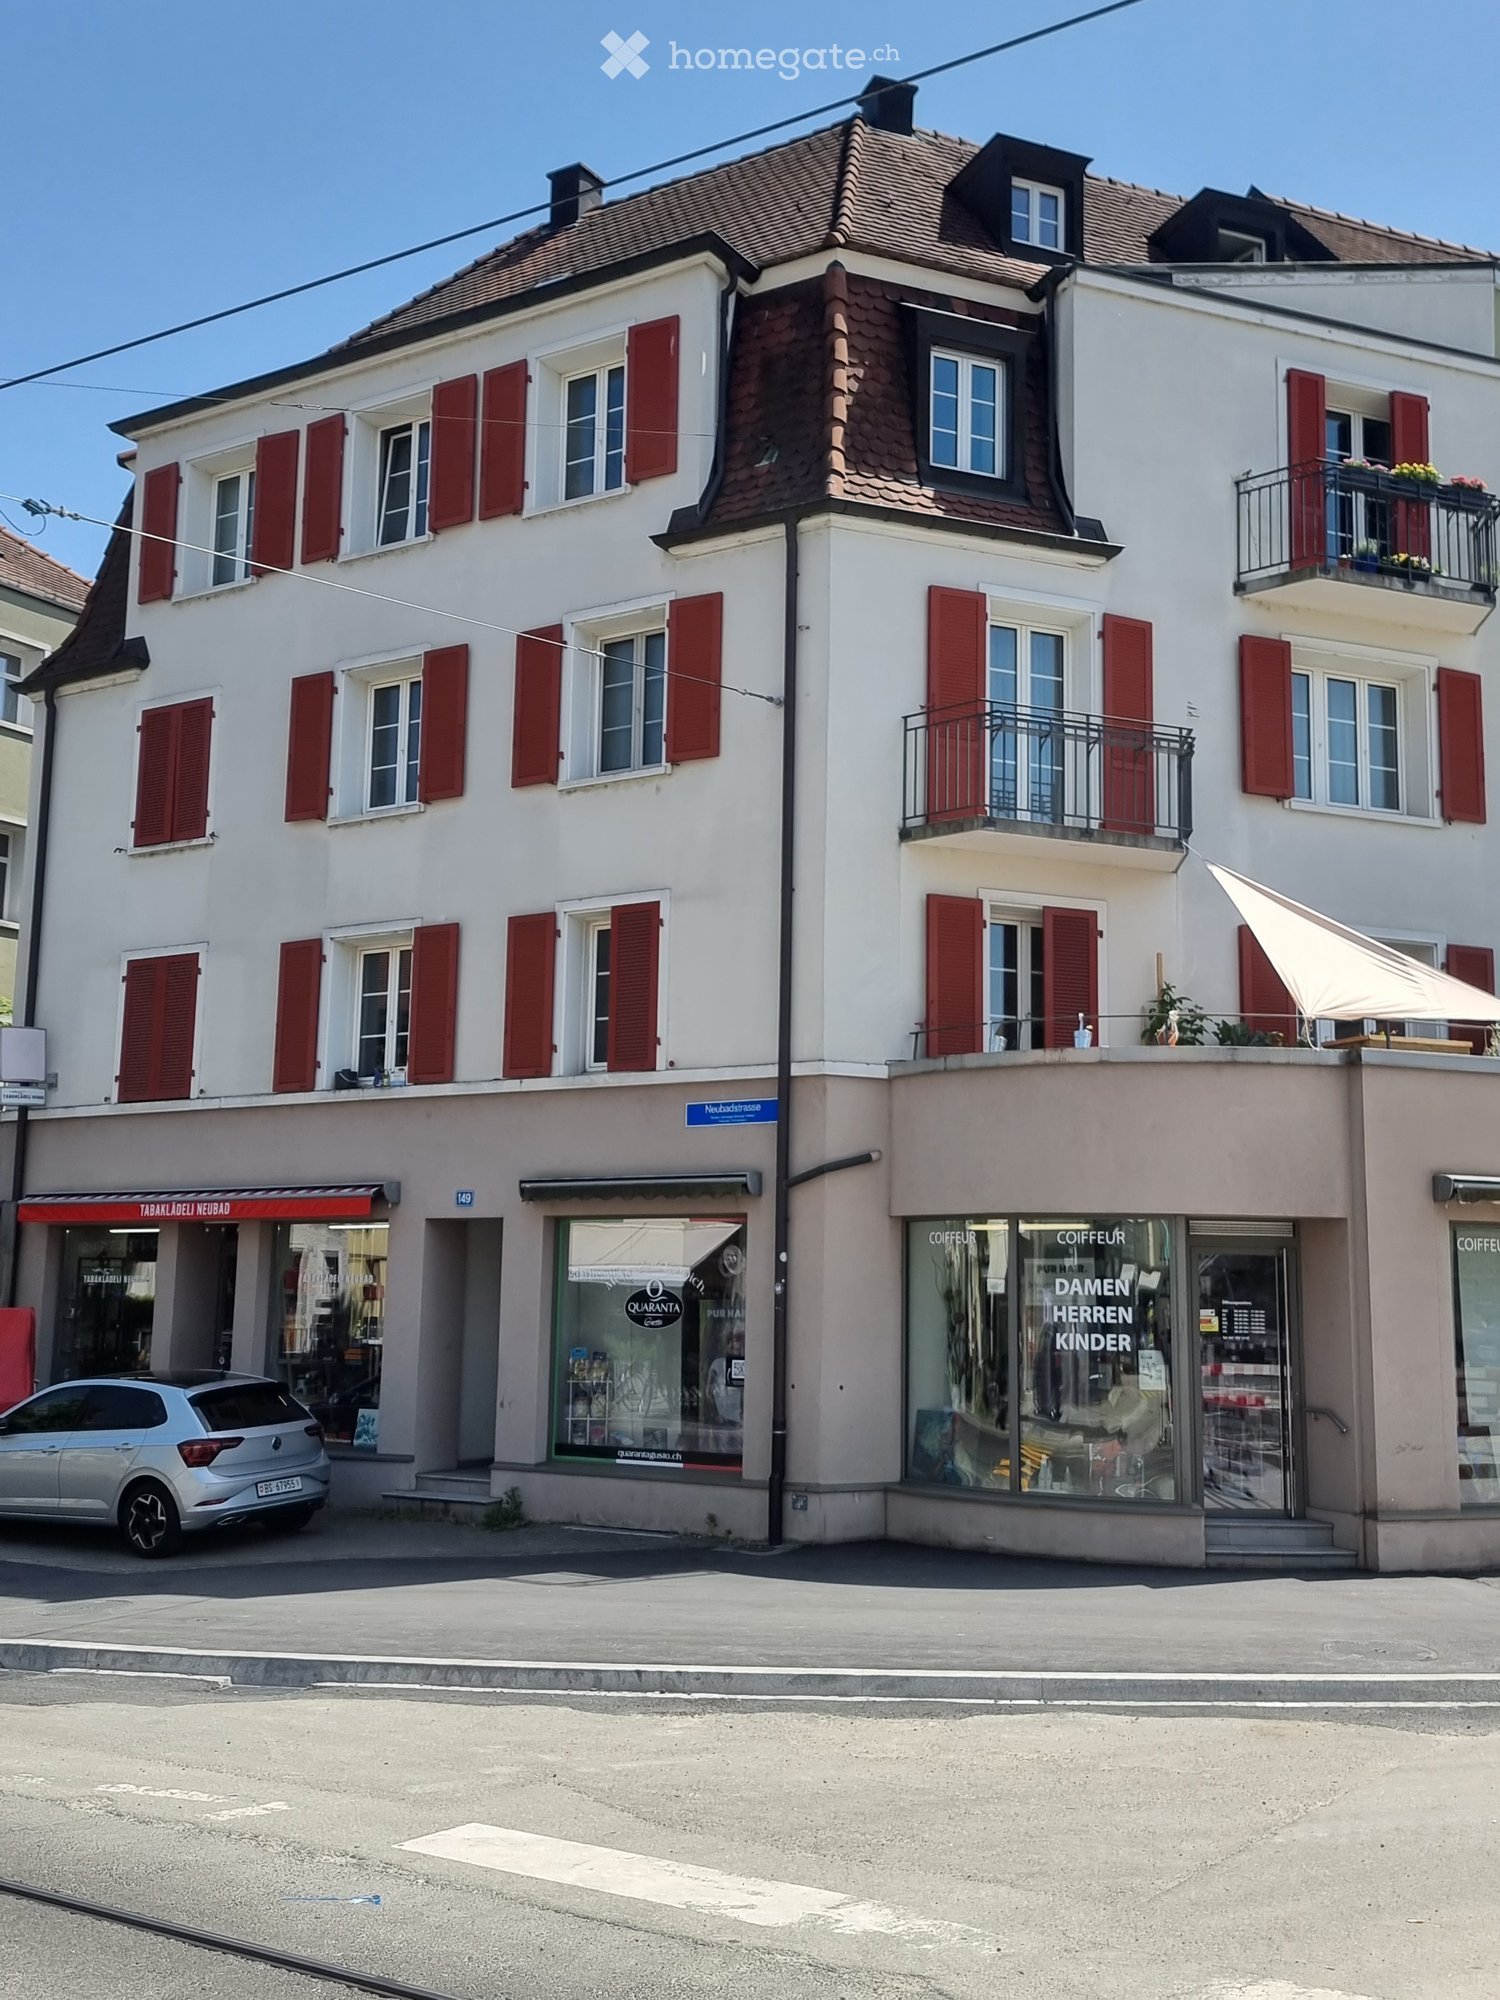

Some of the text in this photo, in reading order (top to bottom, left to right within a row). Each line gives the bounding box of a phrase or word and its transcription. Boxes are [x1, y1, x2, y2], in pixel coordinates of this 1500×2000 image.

[704, 1103, 762, 1114] Neubadstrasse
[457, 1192, 472, 1204] 149
[140, 1202, 231, 1217] TABAKLÄDELI NEUBAD
[929, 1231, 976, 1245] COIFFEUR
[1056, 1231, 1126, 1245] COIFFEUR
[1037, 1264, 1088, 1274] PUR HAR.
[1055, 1278, 1130, 1296] DAMEN
[627, 1301, 681, 1314] QUARANTA
[707, 1308, 726, 1318] PUR
[1053, 1306, 1133, 1324] HERREN
[1055, 1333, 1131, 1351] KINDER
[617, 1449, 682, 1461] quarantagusto.ch
